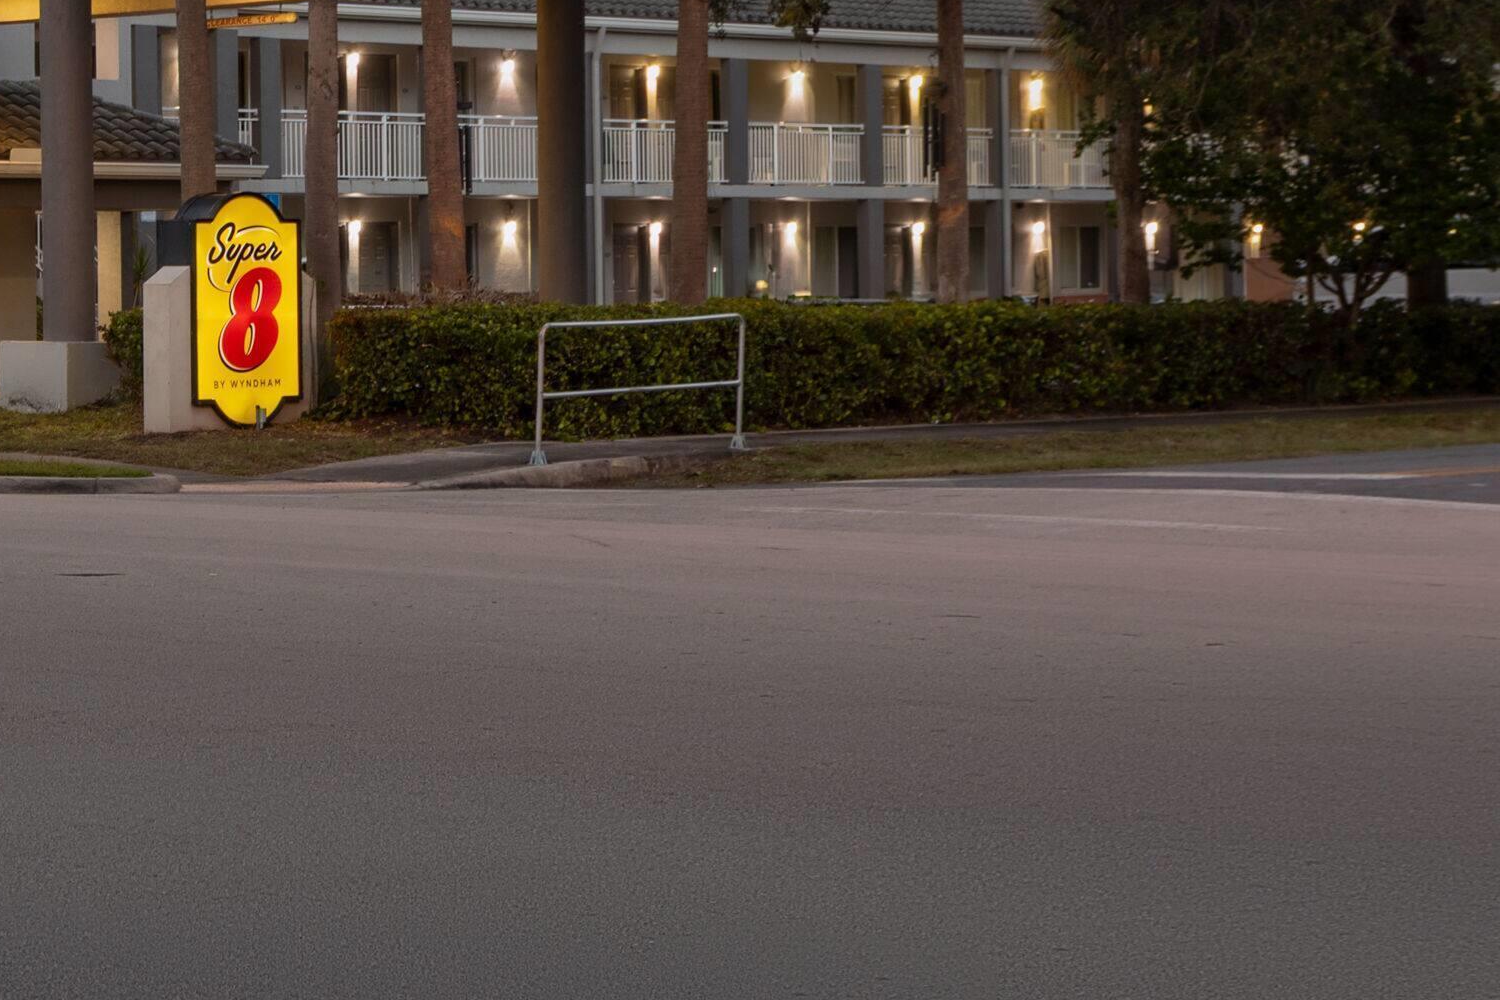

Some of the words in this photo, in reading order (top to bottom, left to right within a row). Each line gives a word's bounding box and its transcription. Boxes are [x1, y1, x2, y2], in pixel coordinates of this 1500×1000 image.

[208, 222, 283, 284] Super
[218, 266, 282, 372] 8
[213, 380, 226, 389] BY
[231, 378, 281, 388] WYNDHAM
